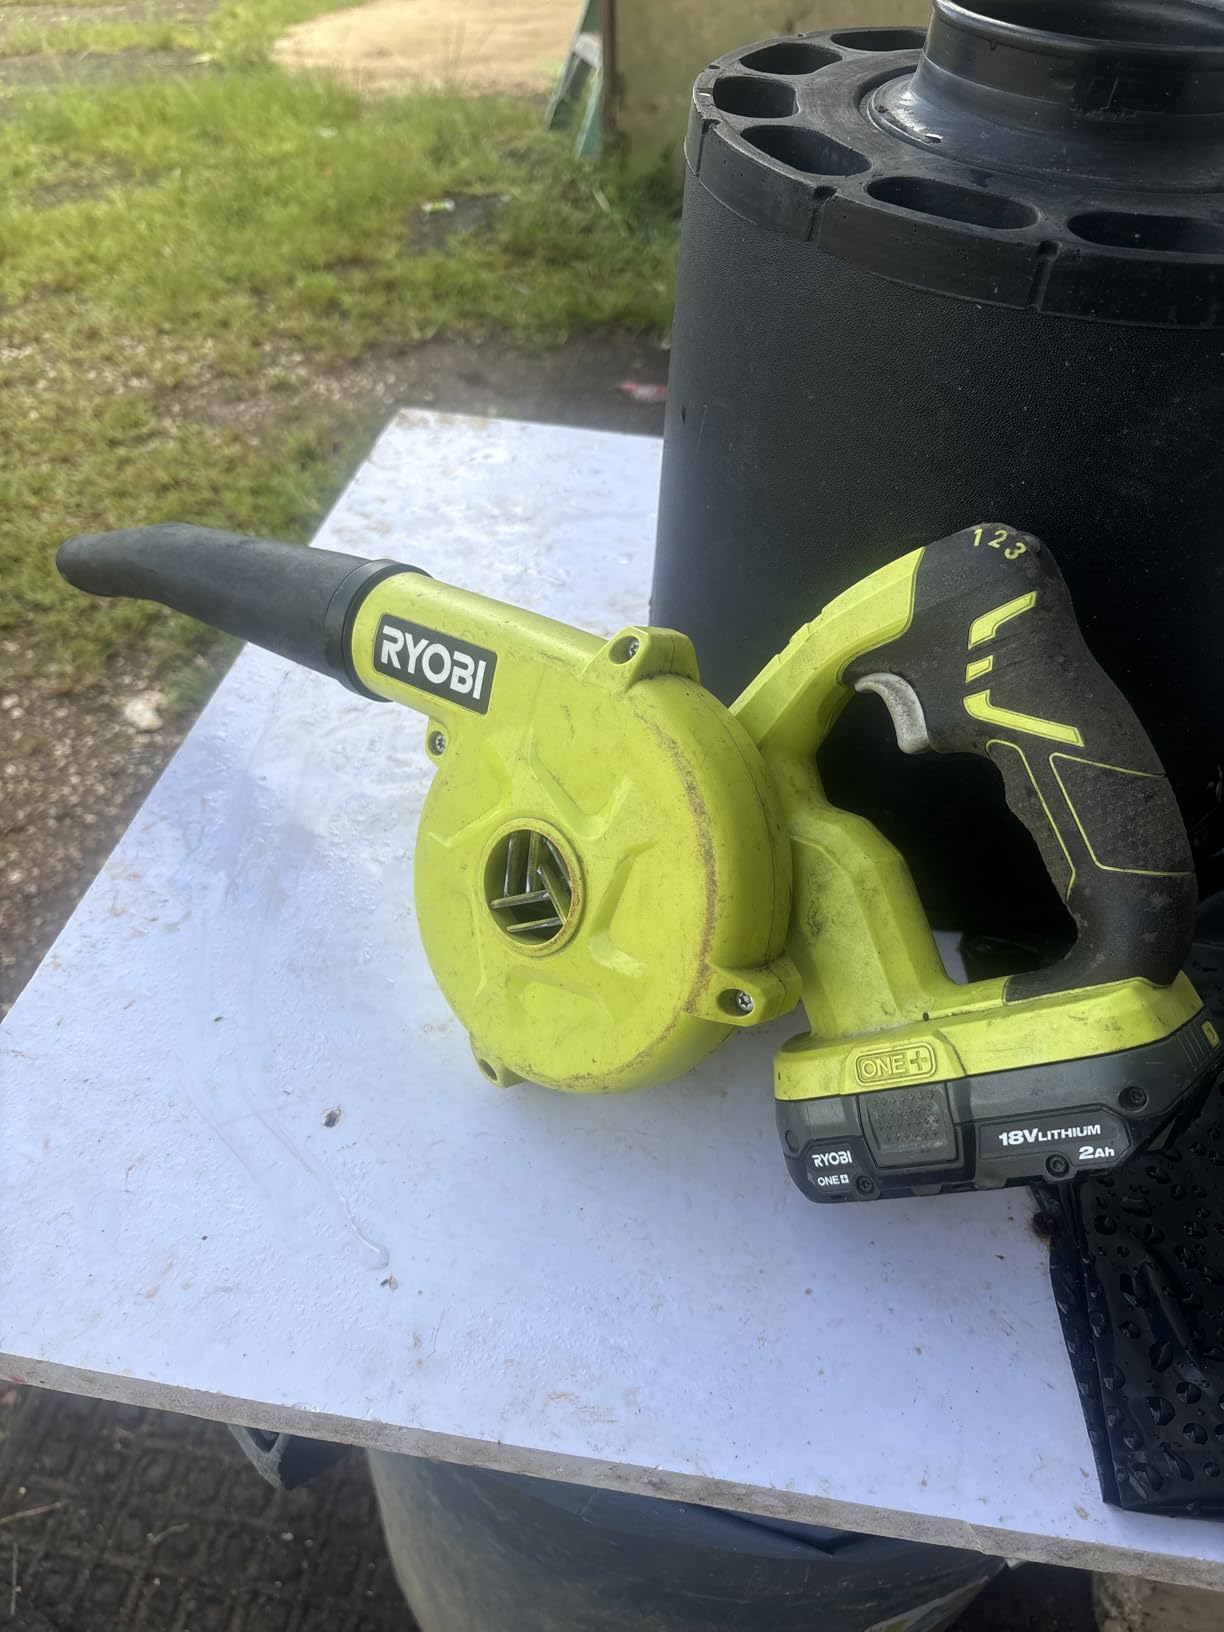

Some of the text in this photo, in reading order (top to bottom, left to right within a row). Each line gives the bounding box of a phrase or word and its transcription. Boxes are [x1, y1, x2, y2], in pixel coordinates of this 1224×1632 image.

[973, 528, 1027, 560] 1 2 3
[381, 625, 487, 700] RYOBI
[812, 1150, 853, 1168] RYOBI
[1078, 1146, 1116, 1160] 2Ah
